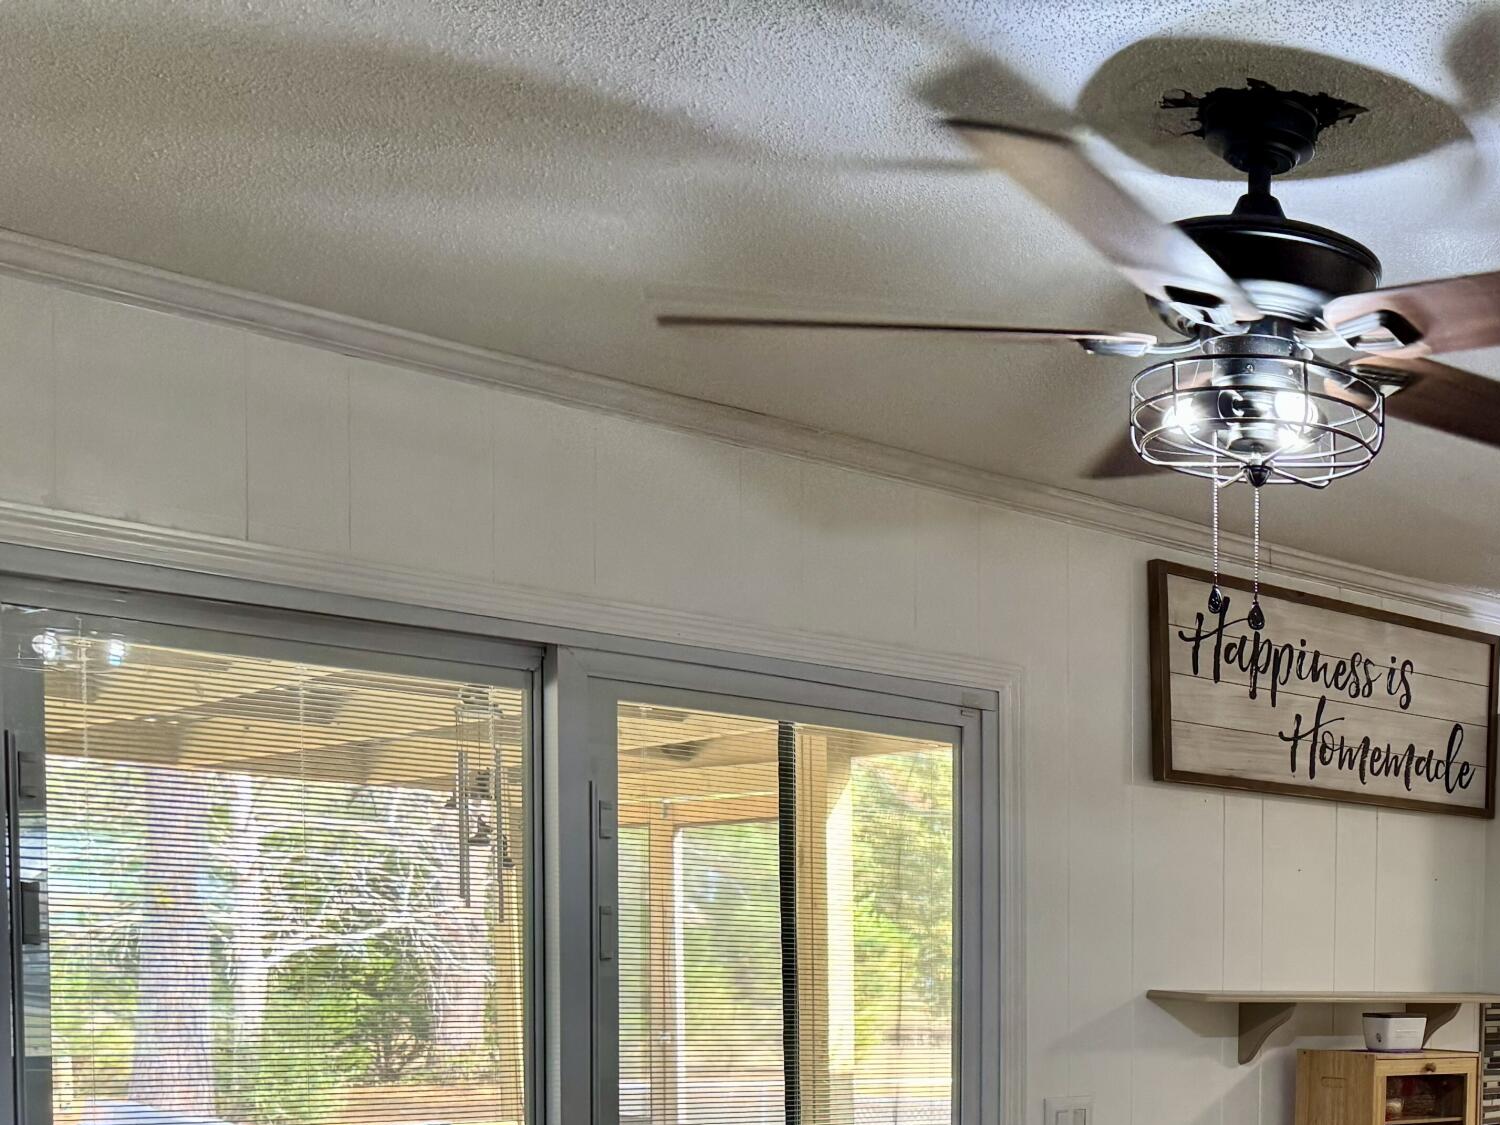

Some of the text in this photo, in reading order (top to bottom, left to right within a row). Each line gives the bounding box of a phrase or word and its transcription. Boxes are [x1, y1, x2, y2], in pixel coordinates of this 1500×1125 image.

[1179, 597, 1414, 710] Happiness is
[1278, 695, 1476, 794] Homemade
